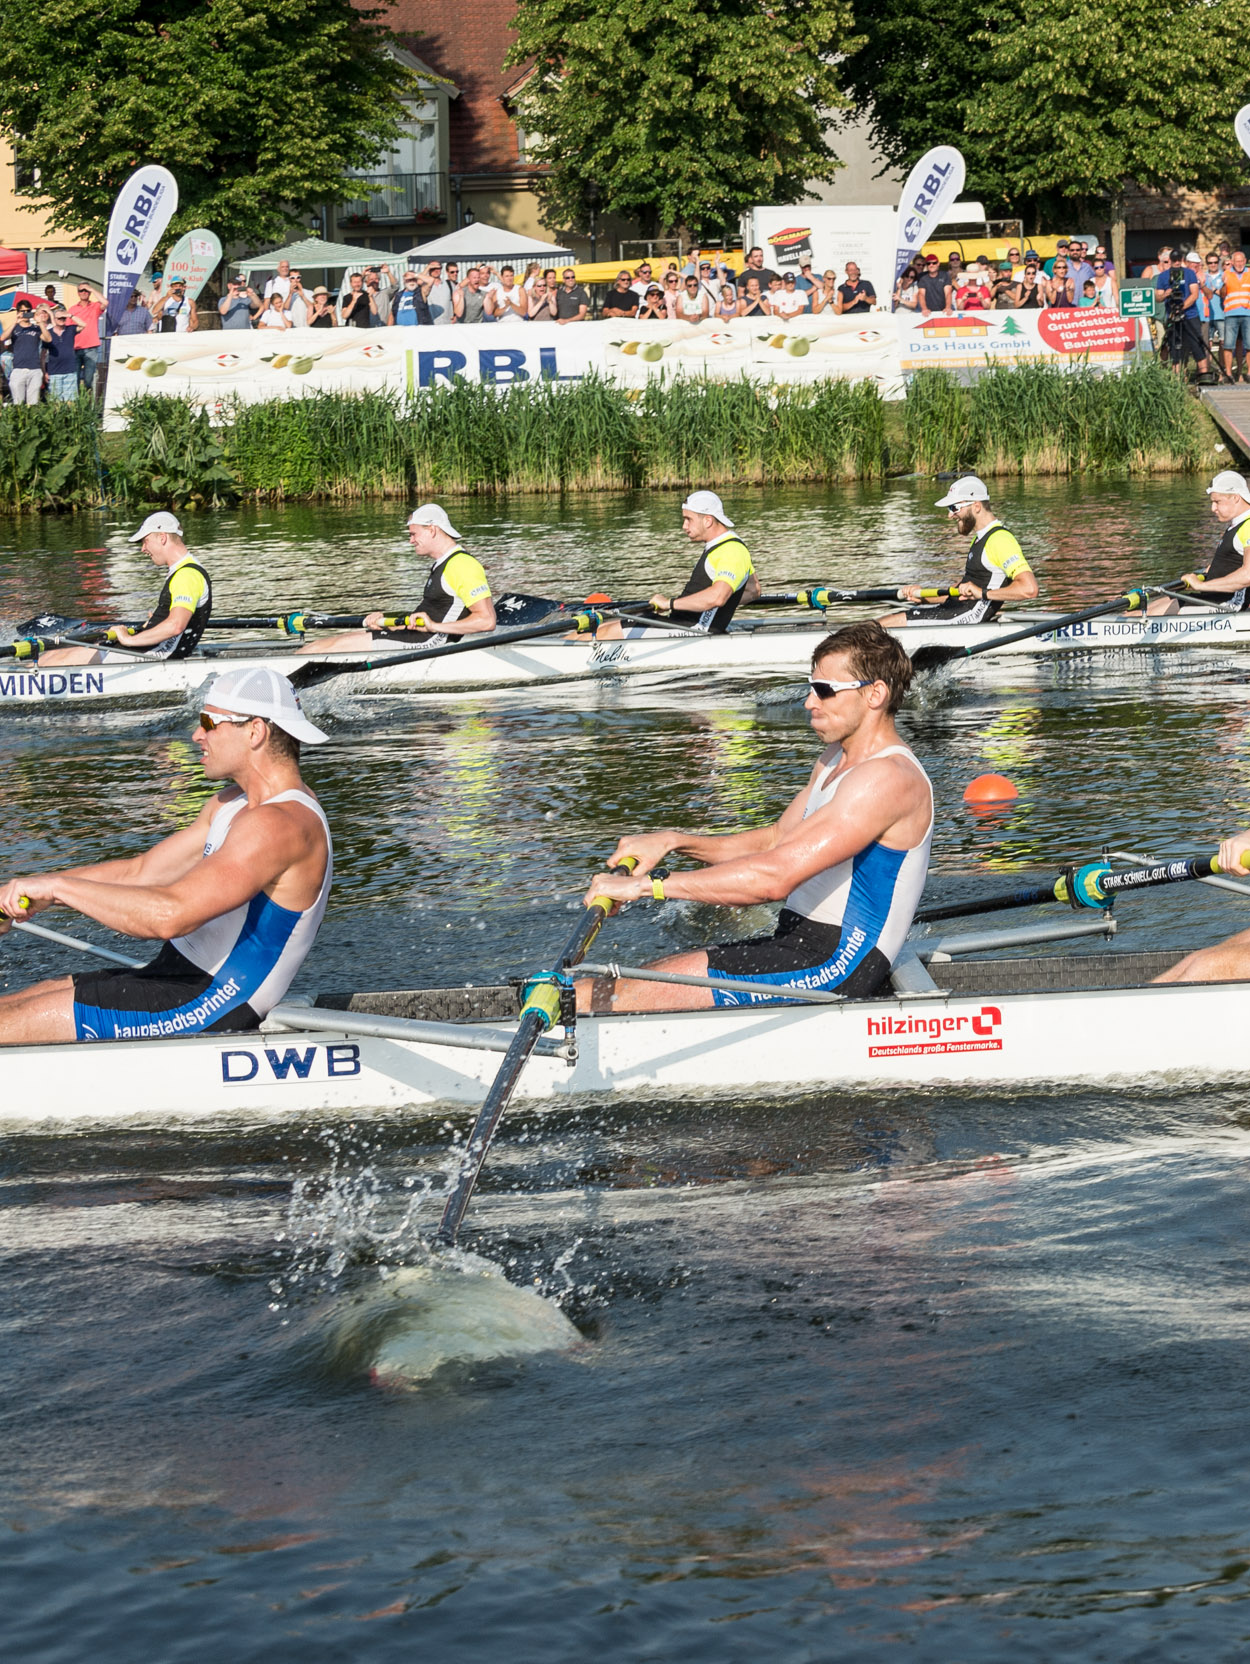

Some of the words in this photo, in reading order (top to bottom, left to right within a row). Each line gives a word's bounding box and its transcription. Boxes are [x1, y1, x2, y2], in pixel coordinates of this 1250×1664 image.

[914, 162, 951, 215] RBL
[125, 182, 161, 237] RBL
[171, 262, 188, 272] 100
[109, 273, 129, 281] STARK.
[109, 280, 133, 288] SCHNELL.
[1048, 310, 1073, 322] Wir
[1074, 307, 1119, 318] suchen
[1059, 329, 1079, 340] für
[1081, 326, 1125, 338] unsere
[910, 342, 939, 353] Das
[945, 341, 985, 351] Haus
[991, 340, 1031, 349] GmbH
[1063, 335, 1131, 350] Bauherren
[418, 347, 585, 388] RBL
[1057, 622, 1098, 637] RBL
[1103, 619, 1232, 636] RUDER-BUNDESLIGA
[592, 643, 631, 663] Melitta
[0, 672, 104, 701] MINDEN
[1170, 861, 1187, 876] RBL
[1103, 874, 1125, 888] STARK.
[1124, 870, 1152, 887] SCHNELL.
[1152, 867, 1167, 880] GUT.
[867, 1015, 969, 1039] hilzinger
[871, 1044, 922, 1057] Deutschlands
[922, 1043, 945, 1054] große
[946, 1041, 1000, 1052] Fenstermarke.
[221, 1044, 361, 1083] DWB
